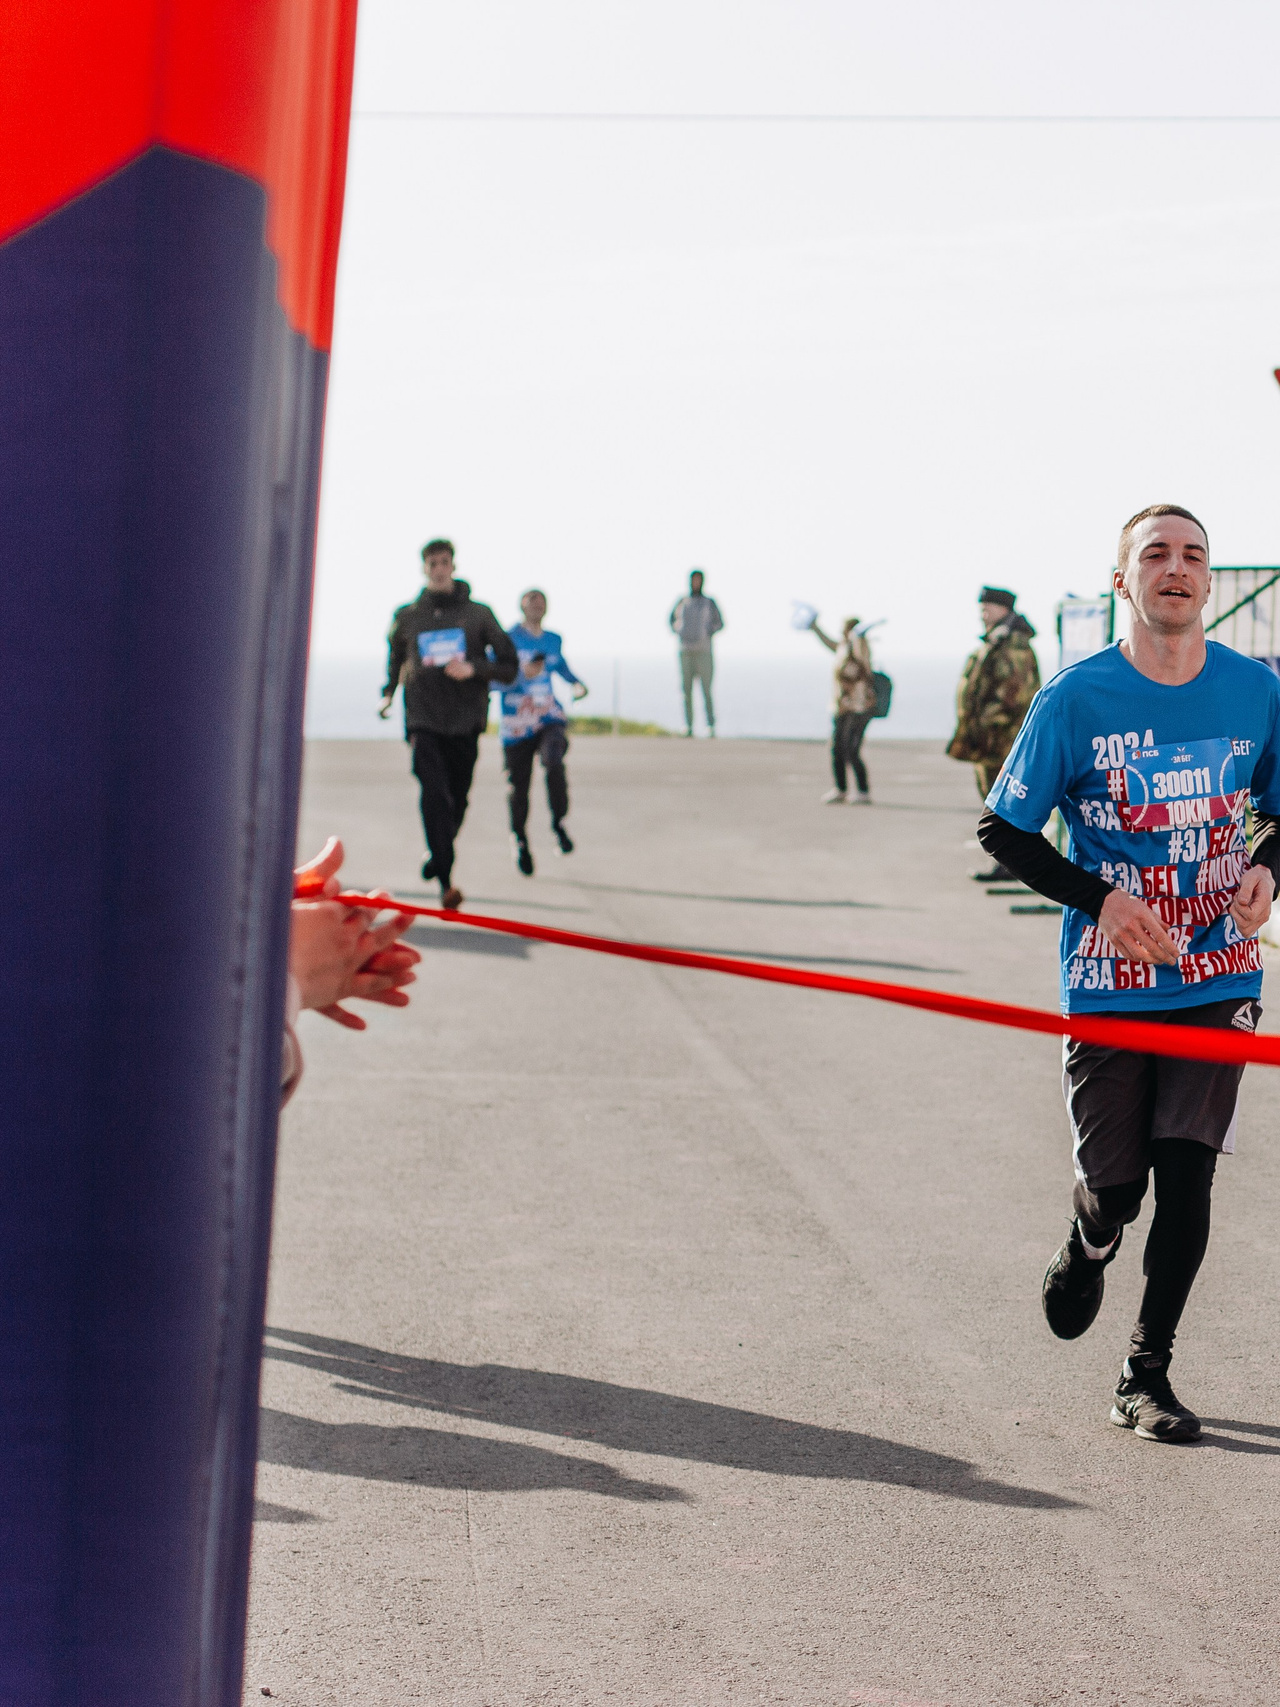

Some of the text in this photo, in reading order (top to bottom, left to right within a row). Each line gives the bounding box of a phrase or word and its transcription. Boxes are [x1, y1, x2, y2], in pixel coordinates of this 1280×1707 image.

[1142, 750, 1159, 758] ПСБ
[1002, 772, 1028, 799] ПСБ
[1152, 767, 1211, 799] 30011
[1079, 798, 1153, 832] #ЗАБ
[1168, 824, 1237, 863] #ЗАБЕГ
[1100, 861, 1179, 897] #ЗАБЕГ
[1068, 957, 1156, 990] #ЗАБЕГ
[1231, 1018, 1255, 1034] Reebok
